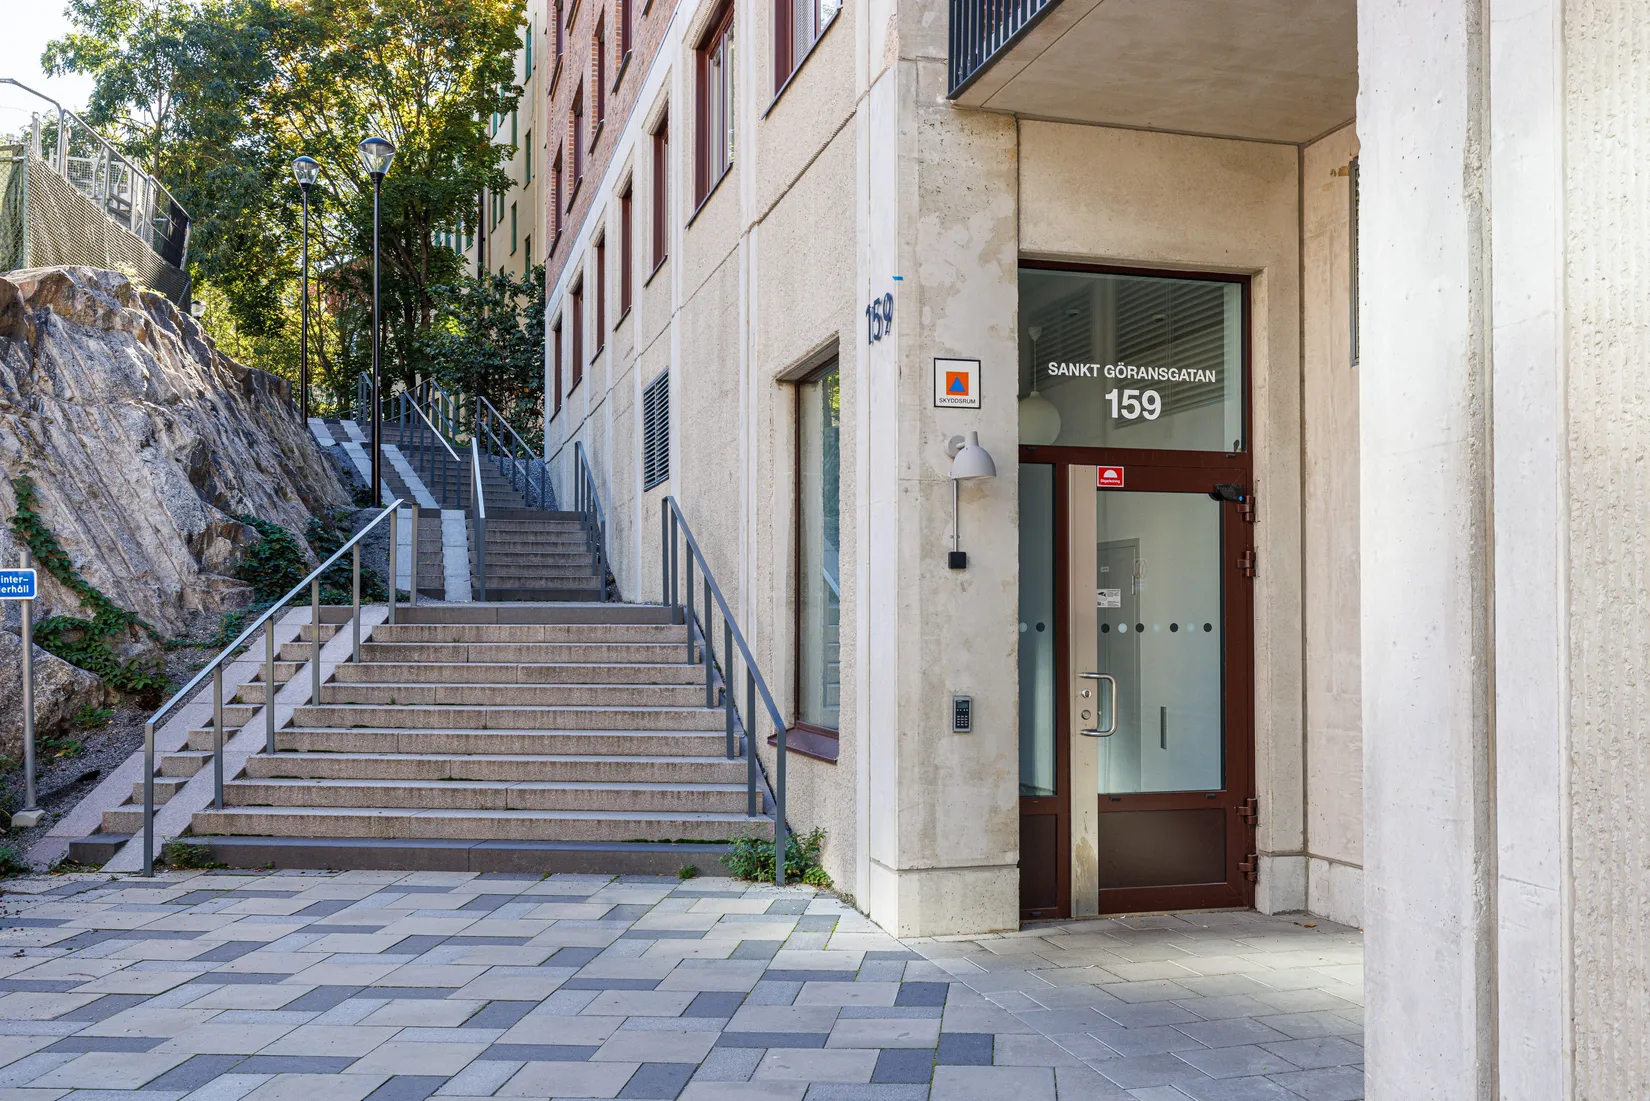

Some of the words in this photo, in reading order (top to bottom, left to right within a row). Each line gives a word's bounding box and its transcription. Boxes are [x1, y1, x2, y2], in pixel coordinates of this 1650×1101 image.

[866, 292, 893, 345] 159
[1048, 362, 1100, 377] SANKT
[1104, 362, 1216, 383] GÖRANSGATAN
[1105, 388, 1162, 420] 159
[0, 575, 29, 583] inter-
[0, 585, 29, 593] erhåll
